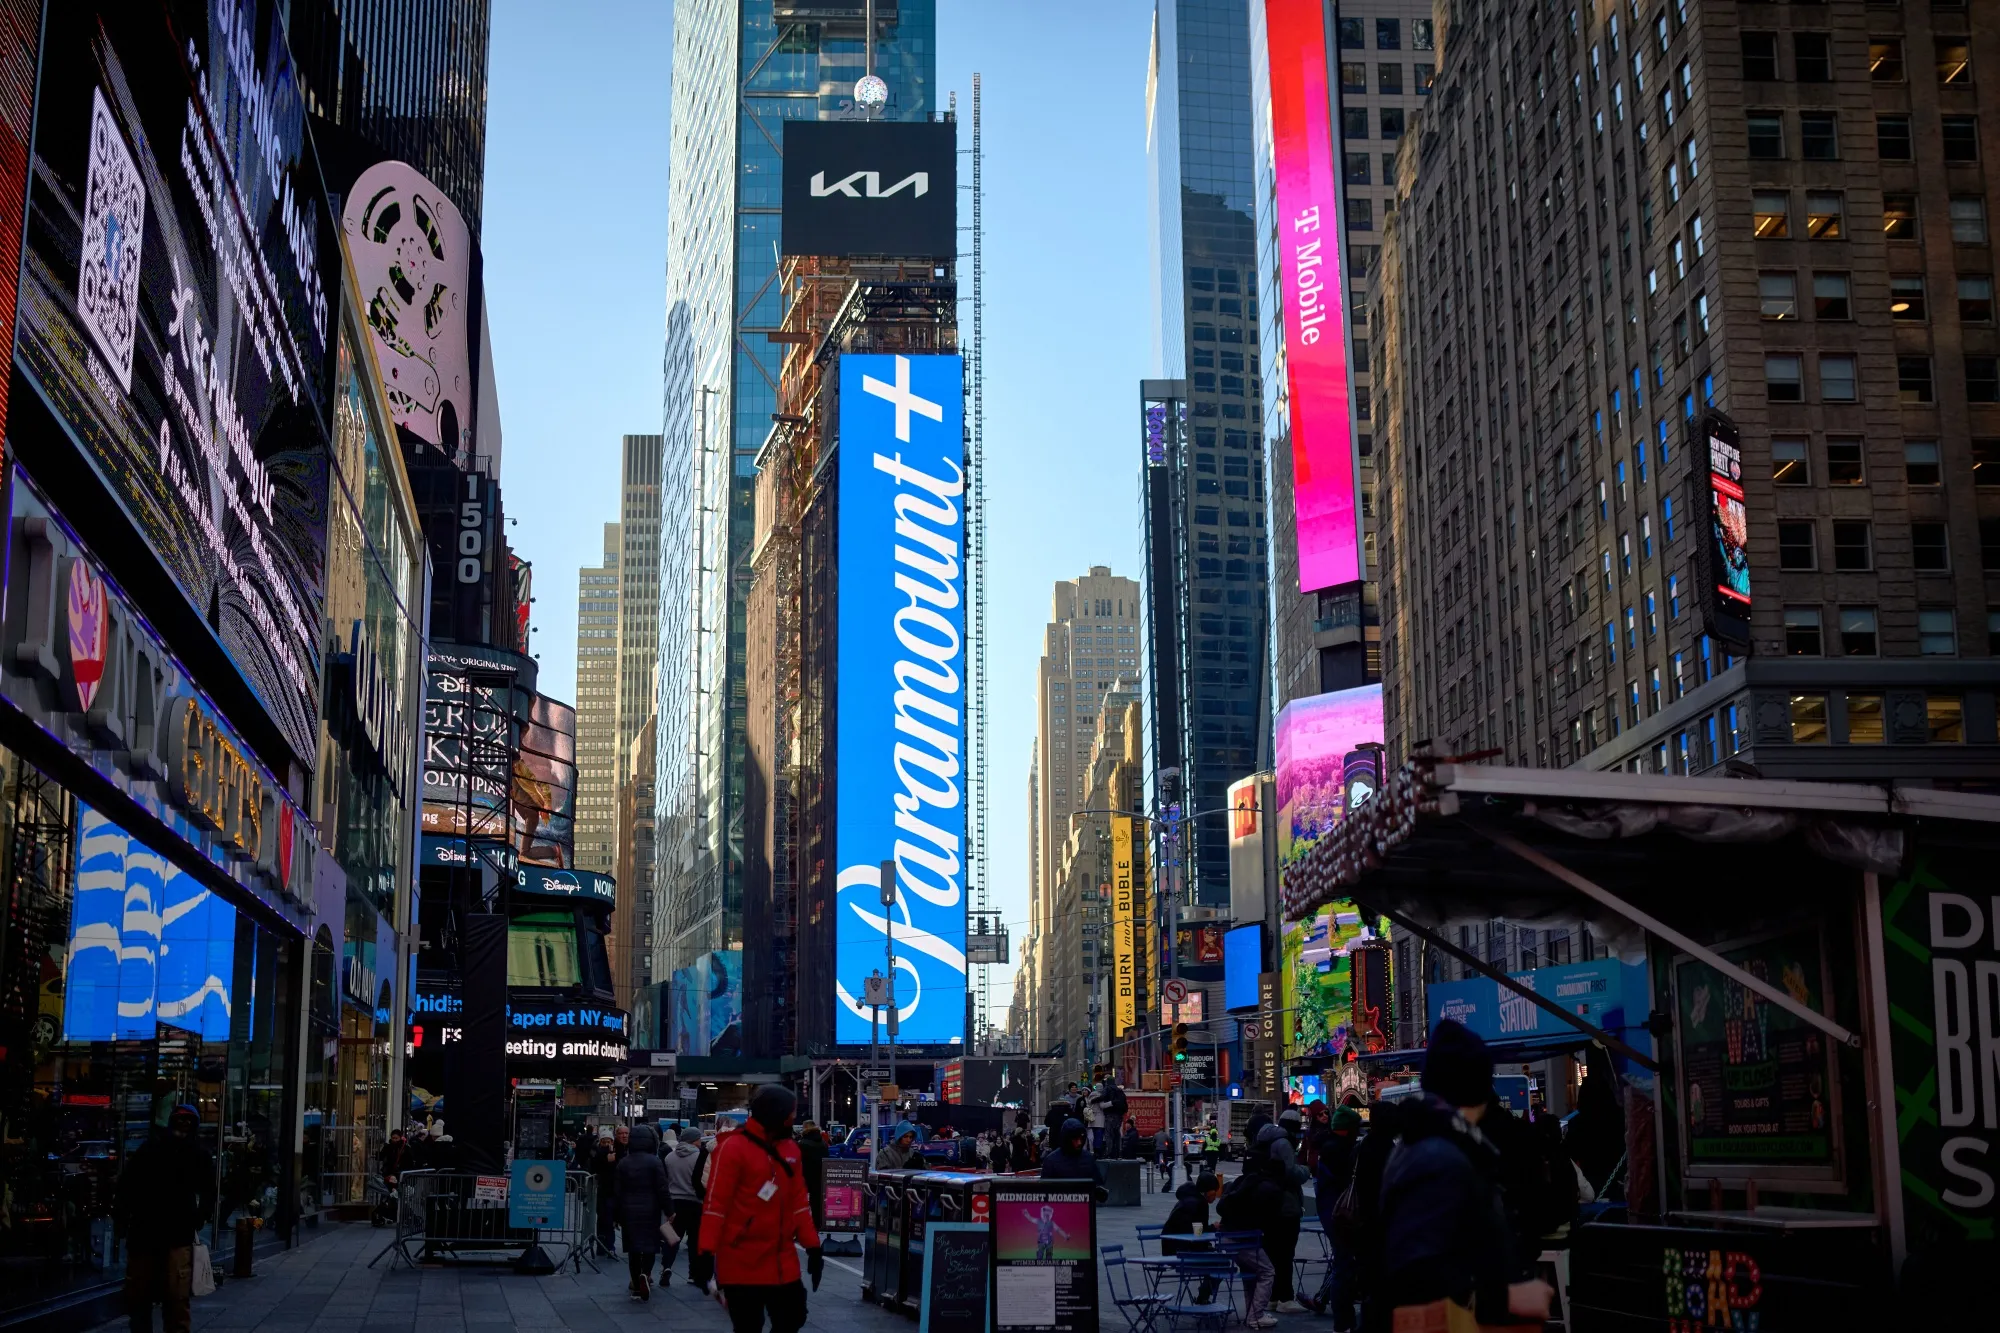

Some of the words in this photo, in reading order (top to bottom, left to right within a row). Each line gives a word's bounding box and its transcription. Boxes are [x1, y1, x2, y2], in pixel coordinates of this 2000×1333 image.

[810, 170, 929, 199] KIA
[181, 131, 221, 247] becoming
[224, 251, 254, 331] published
[282, 171, 314, 306] MADE
[1296, 237, 1327, 346] Mobile
[192, 319, 208, 388] EC
[208, 357, 258, 498] Publishing
[259, 464, 274, 524] LLC
[181, 469, 199, 518] South
[457, 474, 482, 584] 1500
[460, 657, 500, 671] ORIGINAL
[355, 618, 383, 753] OLD
[383, 677, 412, 812] NAVY
[542, 876, 582, 895] Disney+
[1123, 915, 1132, 947] more
[1120, 953, 1132, 997] BURN
[512, 1012, 553, 1029] aper
[556, 1011, 575, 1025] at
[580, 1010, 602, 1026] NY
[603, 1011, 623, 1031] airport
[1120, 1002, 1133, 1026] less
[1263, 982, 1274, 1038] SQUARE
[1446, 1003, 1477, 1015] FOUNTAIN
[1499, 998, 1538, 1033] STATION
[506, 1039, 557, 1058] eeting
[562, 1039, 599, 1056] amid
[600, 1041, 620, 1062] cloudy
[1265, 1051, 1274, 1093] TIMES
[1728, 1070, 1743, 1087] UP
[1743, 1065, 1773, 1086] CLOSE
[941, 1081, 949, 1102] BAR
[1733, 1099, 1751, 1109] TOURS
[1754, 1096, 1770, 1107] GIFTS
[1127, 1108, 1161, 1117] PRODUCE
[1728, 1124, 1743, 1134] BOOK
[1743, 1123, 1757, 1134] YOUR
[1756, 1123, 1771, 1133] TOUR
[1771, 1122, 1780, 1132] AT
[996, 1193, 1046, 1202] MIDNIGHT
